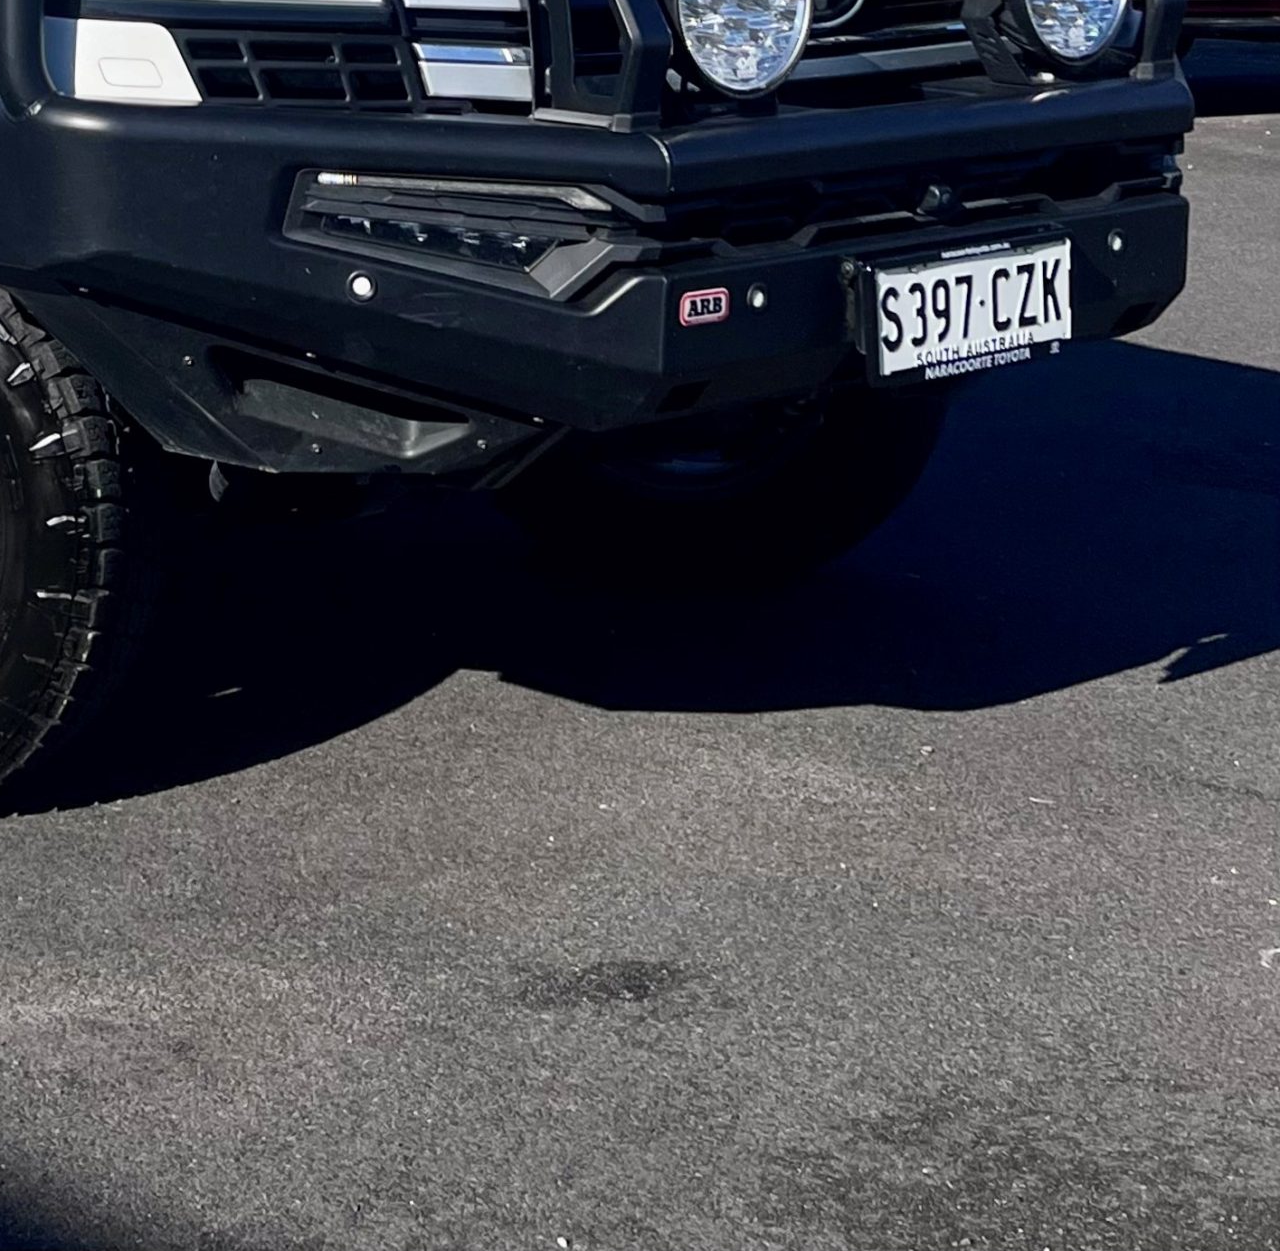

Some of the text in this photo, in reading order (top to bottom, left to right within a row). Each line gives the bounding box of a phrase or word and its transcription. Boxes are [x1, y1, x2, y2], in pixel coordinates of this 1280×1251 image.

[687, 296, 723, 318] ARB
[917, 346, 961, 366] SOUTH
[967, 331, 1035, 359] AUSTRALIA
[925, 354, 992, 380] NARACOORTE
[993, 347, 1032, 370] TOYOTA
